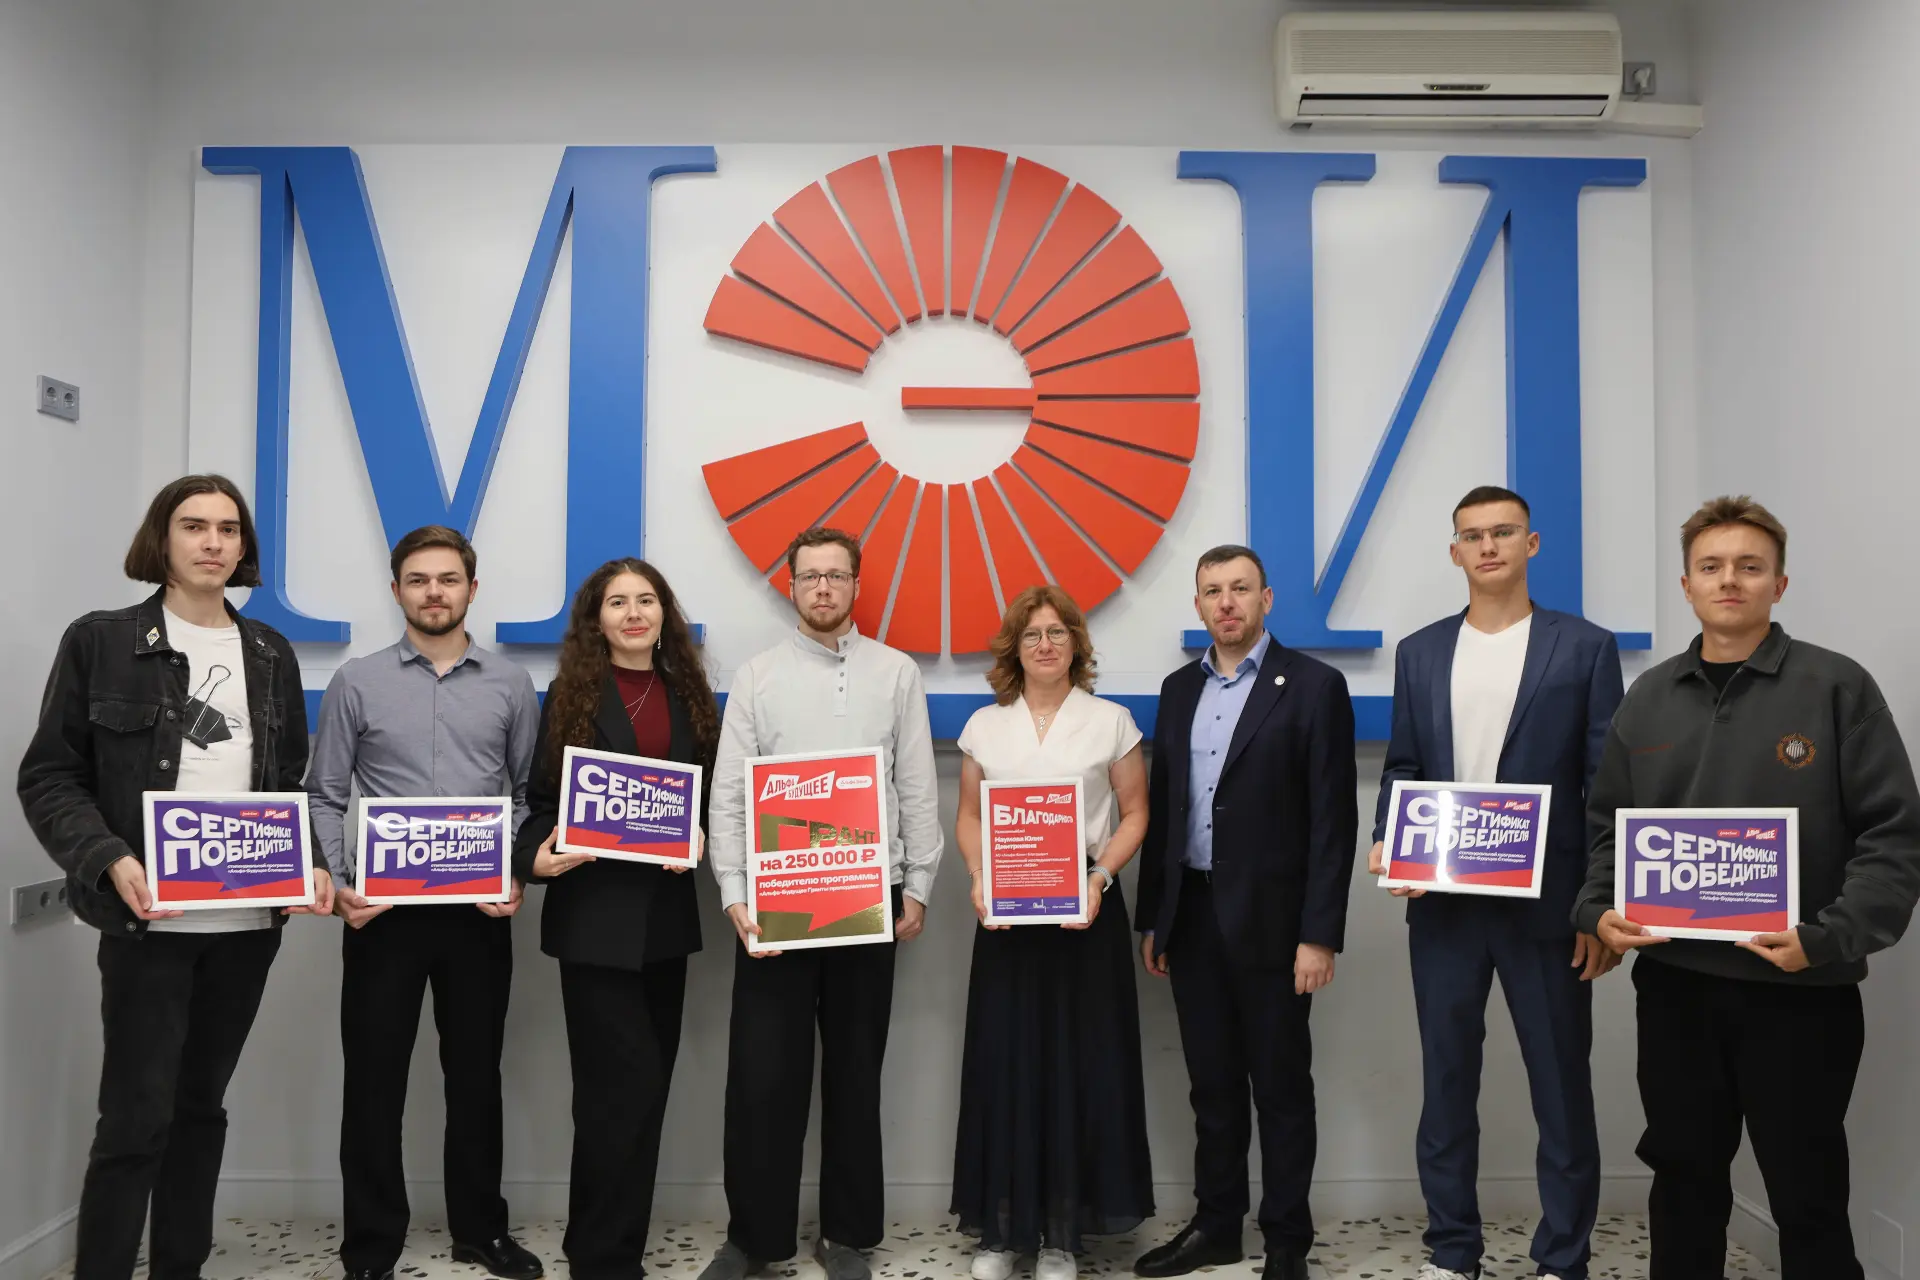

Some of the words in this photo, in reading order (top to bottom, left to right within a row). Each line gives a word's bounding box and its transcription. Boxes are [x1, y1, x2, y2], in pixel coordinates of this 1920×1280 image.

[577, 764, 685, 805] СЕРТИФИКАТ
[788, 776, 829, 799] БУДУЩЕЕ
[162, 807, 292, 839] СЕРТИФИКАТ
[573, 792, 685, 823] ПОБЕДИТЕЛЯ
[760, 813, 876, 853] ГРАНТ
[1634, 825, 1778, 863] СЕРТИФИКАТ
[163, 839, 293, 876] ПОБЕДИТЕЛЯ
[373, 840, 495, 874] ПОБЕДИТЕЛЯ
[760, 859, 782, 871] на
[785, 853, 819, 869] 250
[822, 850, 858, 866] 000
[759, 877, 819, 889] победителю
[820, 873, 879, 885] программы
[1634, 860, 1778, 899] ПОБЕДИТЕЛЯ
